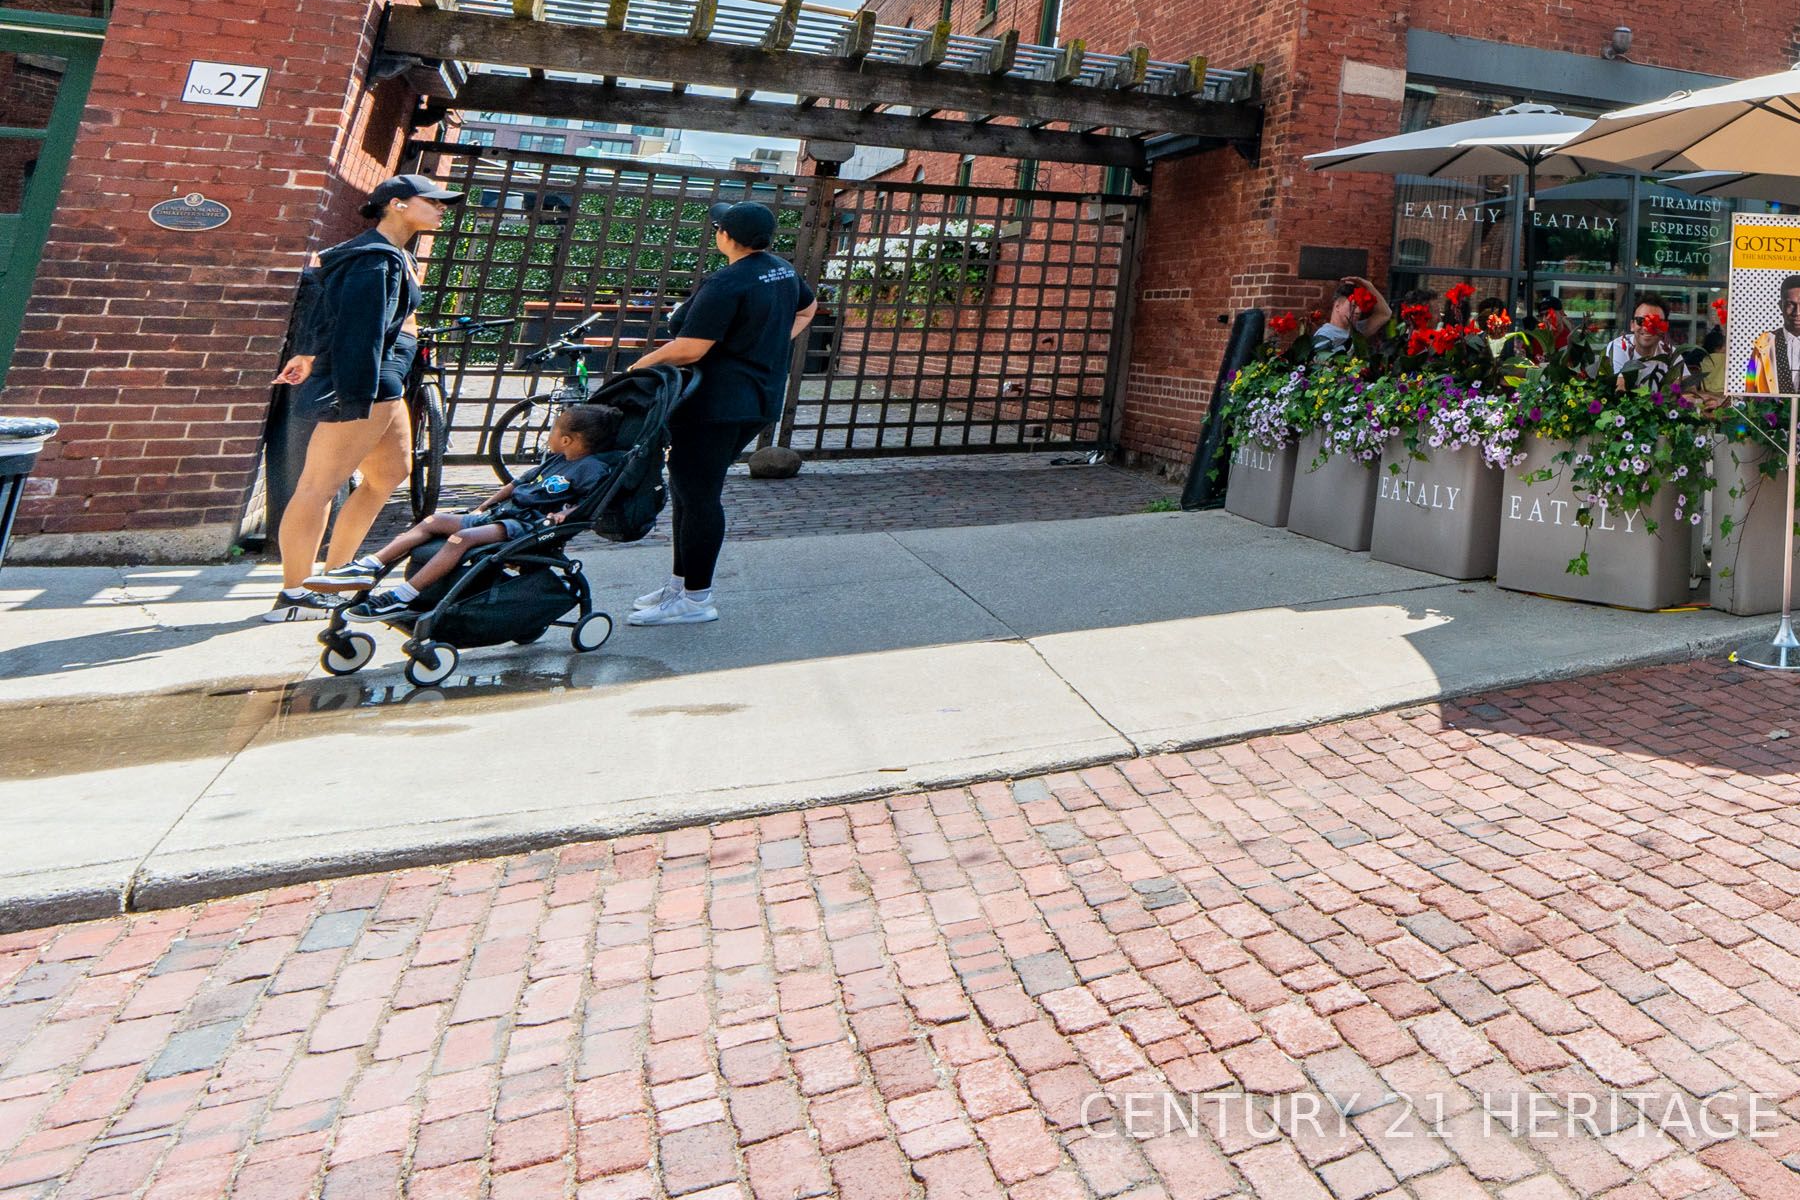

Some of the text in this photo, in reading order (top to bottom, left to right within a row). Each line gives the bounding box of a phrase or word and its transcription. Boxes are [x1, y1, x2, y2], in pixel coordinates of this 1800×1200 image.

[190, 72, 262, 97] No. 27
[1404, 201, 1500, 224] EATALY
[1533, 212, 1618, 232] EATALY
[1650, 221, 1719, 238] ESPRESSO
[1655, 249, 1713, 265] GELATO
[1742, 253, 1756, 261] THE
[1757, 254, 1798, 262] MENSWEAR
[1232, 446, 1275, 471] ATALY
[1381, 476, 1461, 510] EATALY
